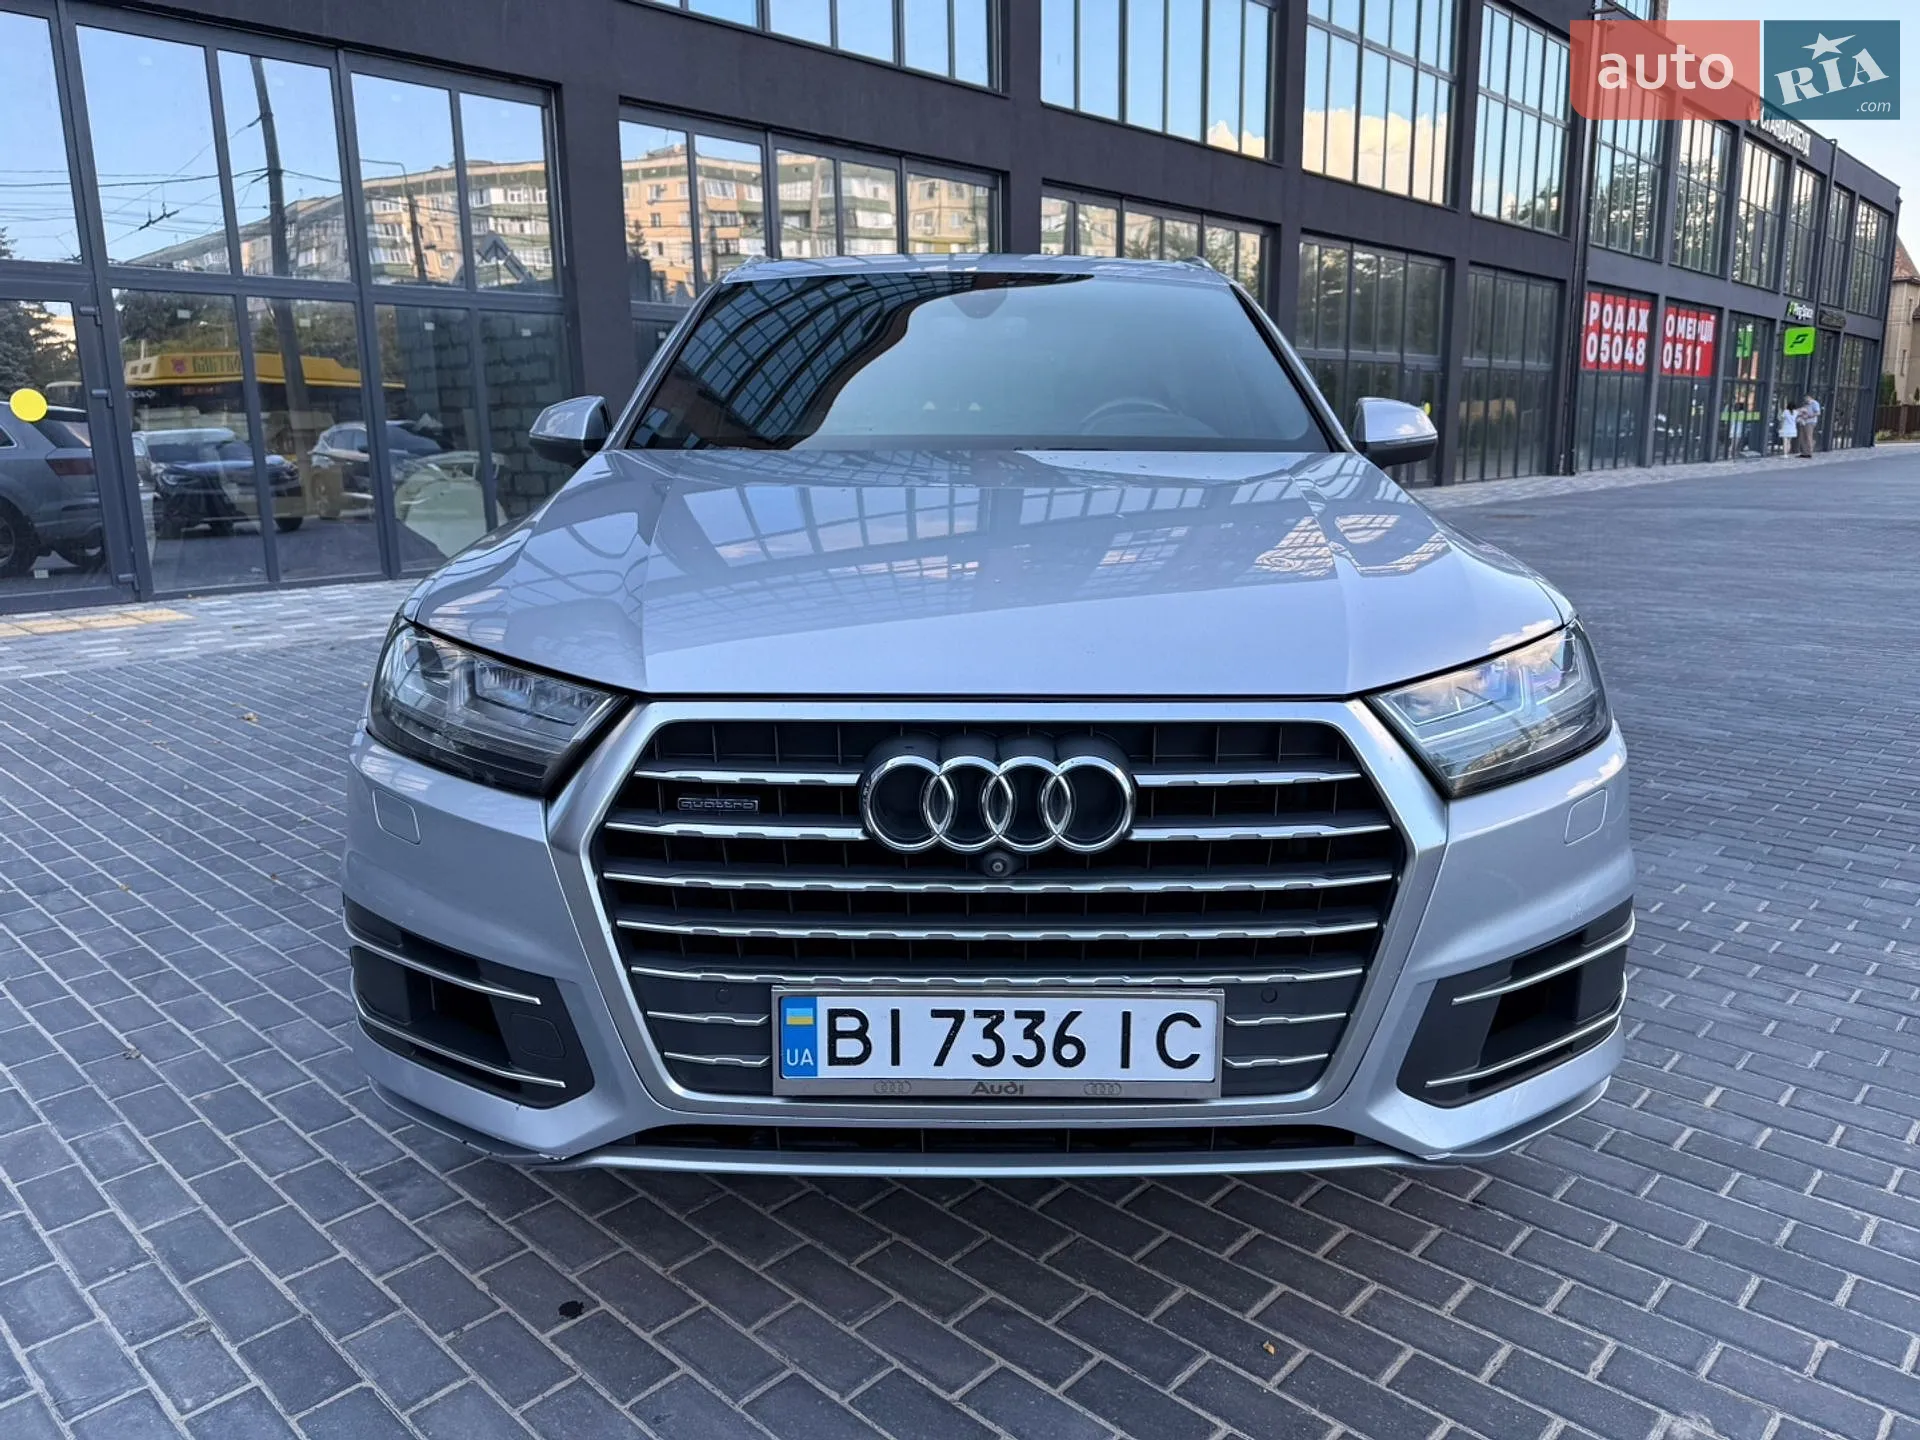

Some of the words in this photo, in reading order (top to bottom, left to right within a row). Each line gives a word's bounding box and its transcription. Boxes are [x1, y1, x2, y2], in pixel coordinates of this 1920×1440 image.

[1586, 332, 1646, 366] 05048
[1662, 342, 1702, 371] 0511
[681, 800, 754, 810] quattro
[827, 1008, 902, 1067] BI
[930, 1009, 1087, 1069] 7336
[1120, 1010, 1201, 1070] IC
[786, 1048, 814, 1067] UA
[971, 1081, 1024, 1095] Audi
